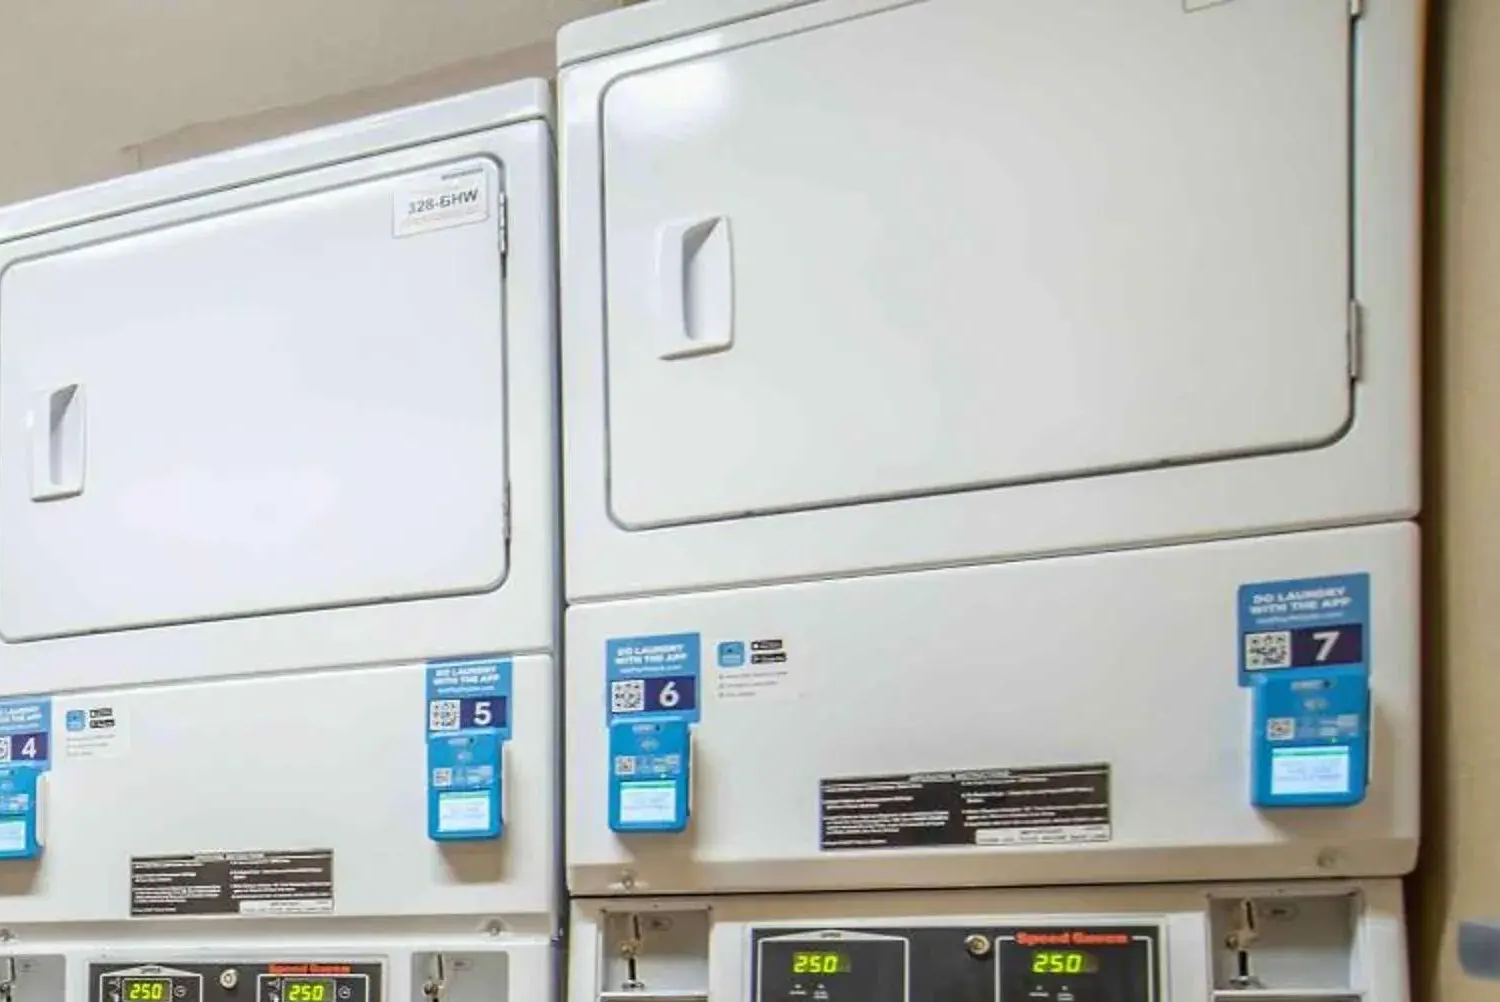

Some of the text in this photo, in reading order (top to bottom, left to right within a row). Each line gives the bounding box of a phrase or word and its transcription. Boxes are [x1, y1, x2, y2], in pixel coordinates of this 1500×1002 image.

[1277, 586, 1346, 601] LAUNDRY
[1250, 597, 1352, 614] WITH THE APP
[1312, 630, 1341, 661] 7
[659, 681, 680, 707] 6
[473, 701, 492, 725] 5
[21, 737, 37, 758] 4
[793, 955, 838, 973] 250
[1032, 954, 1082, 973] 250
[129, 983, 163, 999] 250
[288, 984, 325, 1001] 250
